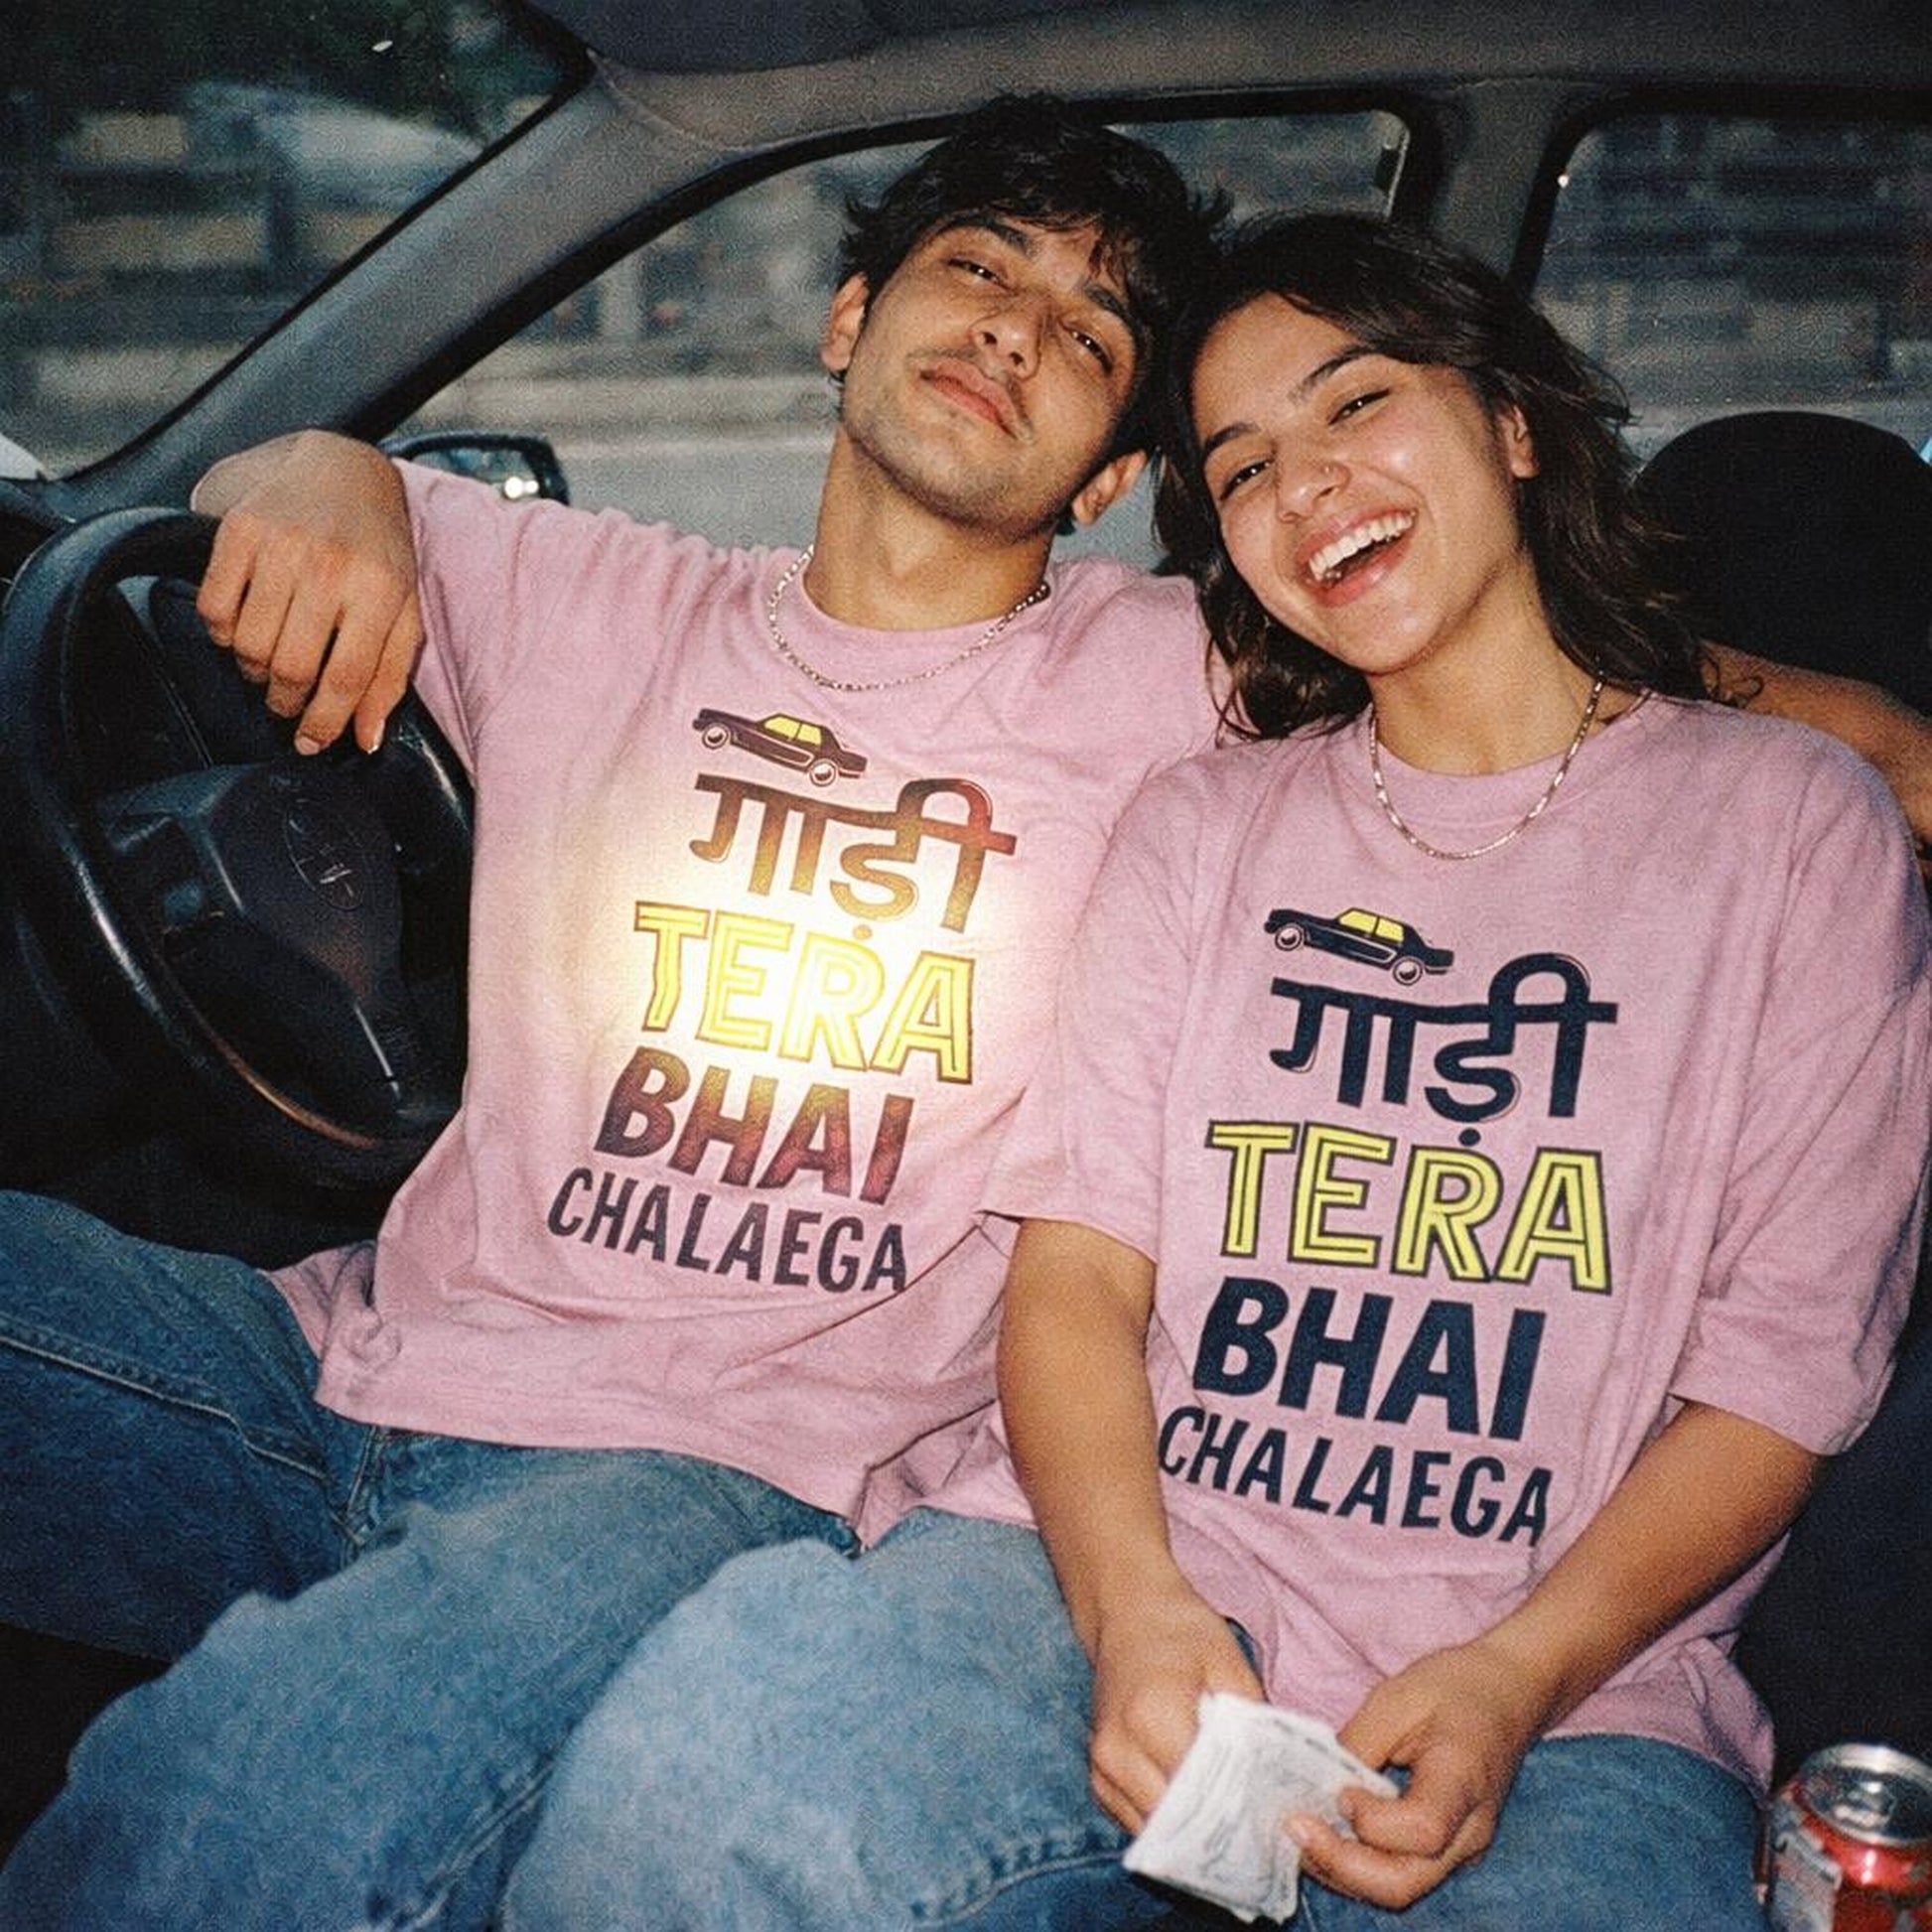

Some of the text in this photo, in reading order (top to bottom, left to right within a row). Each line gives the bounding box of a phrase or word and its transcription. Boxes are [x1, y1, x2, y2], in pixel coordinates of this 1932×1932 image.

[689, 772, 1018, 940] गाड़ी
[634, 900, 976, 1085] TERA
[1269, 952, 1619, 1147] गाड़ी
[595, 1045, 915, 1205] BHAI
[1205, 1119, 1613, 1296] TERA
[547, 1167, 908, 1294] CHALAEGA
[1191, 1276, 1546, 1441] BHAI
[1158, 1406, 1554, 1548] CHALAEGA
